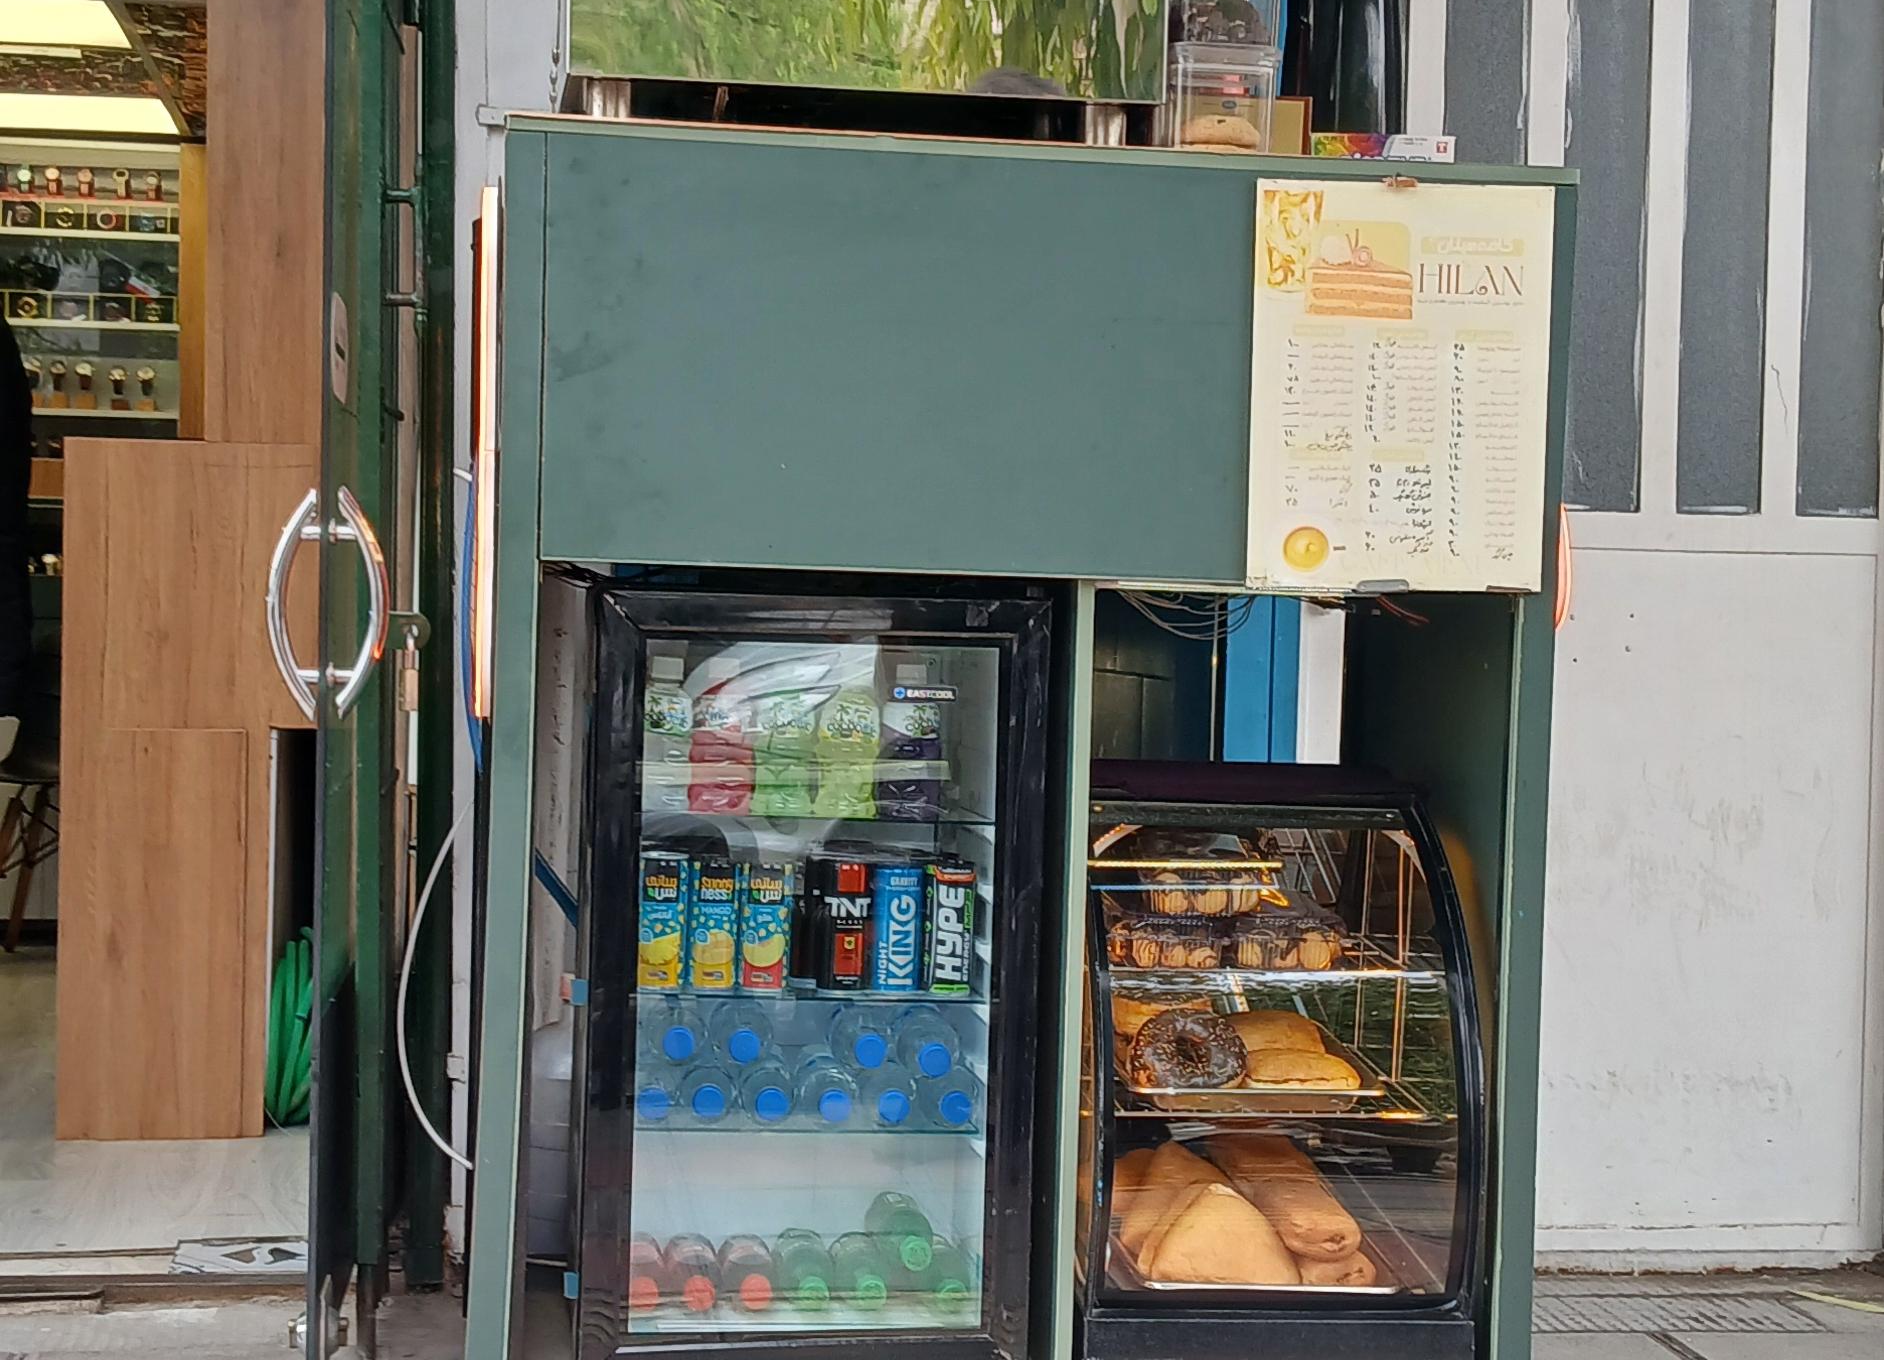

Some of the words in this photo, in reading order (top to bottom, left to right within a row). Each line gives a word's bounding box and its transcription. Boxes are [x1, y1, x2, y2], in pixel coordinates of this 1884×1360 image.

[1418, 262, 1524, 297] HILAN
[823, 896, 872, 918] TNT
[886, 894, 917, 986] KING
[935, 884, 966, 981] HYPE
[877, 940, 889, 986] NIGHT
